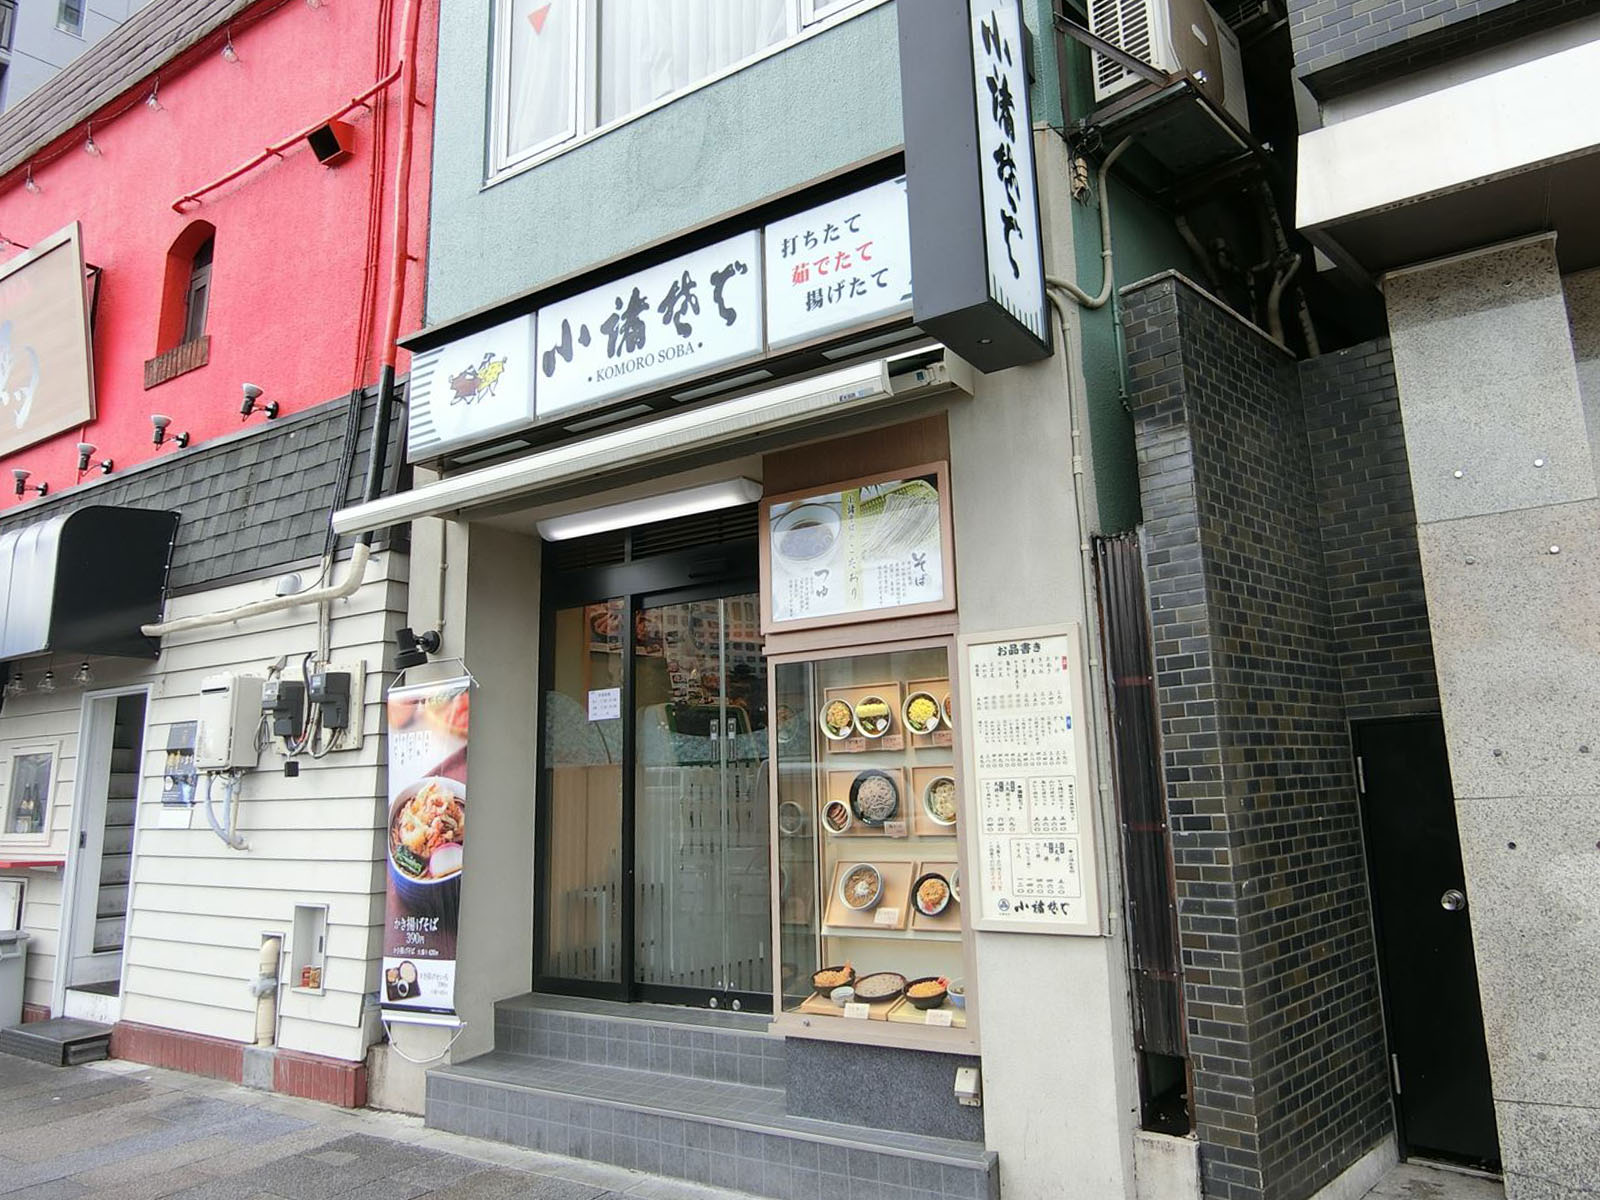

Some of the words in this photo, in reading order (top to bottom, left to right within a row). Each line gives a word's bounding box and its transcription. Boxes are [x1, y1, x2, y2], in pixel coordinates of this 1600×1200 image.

[780, 213, 863, 258] 打ちたて
[790, 241, 875, 287] 茹でたて
[804, 267, 890, 313] 揚げたて
[596, 350, 656, 383] KOMORO
[657, 341, 696, 368] SOBA
[814, 568, 830, 599] つゆ
[911, 551, 927, 588] そば
[997, 642, 1042, 656] お品書き
[393, 916, 440, 932] かき揚げそば
